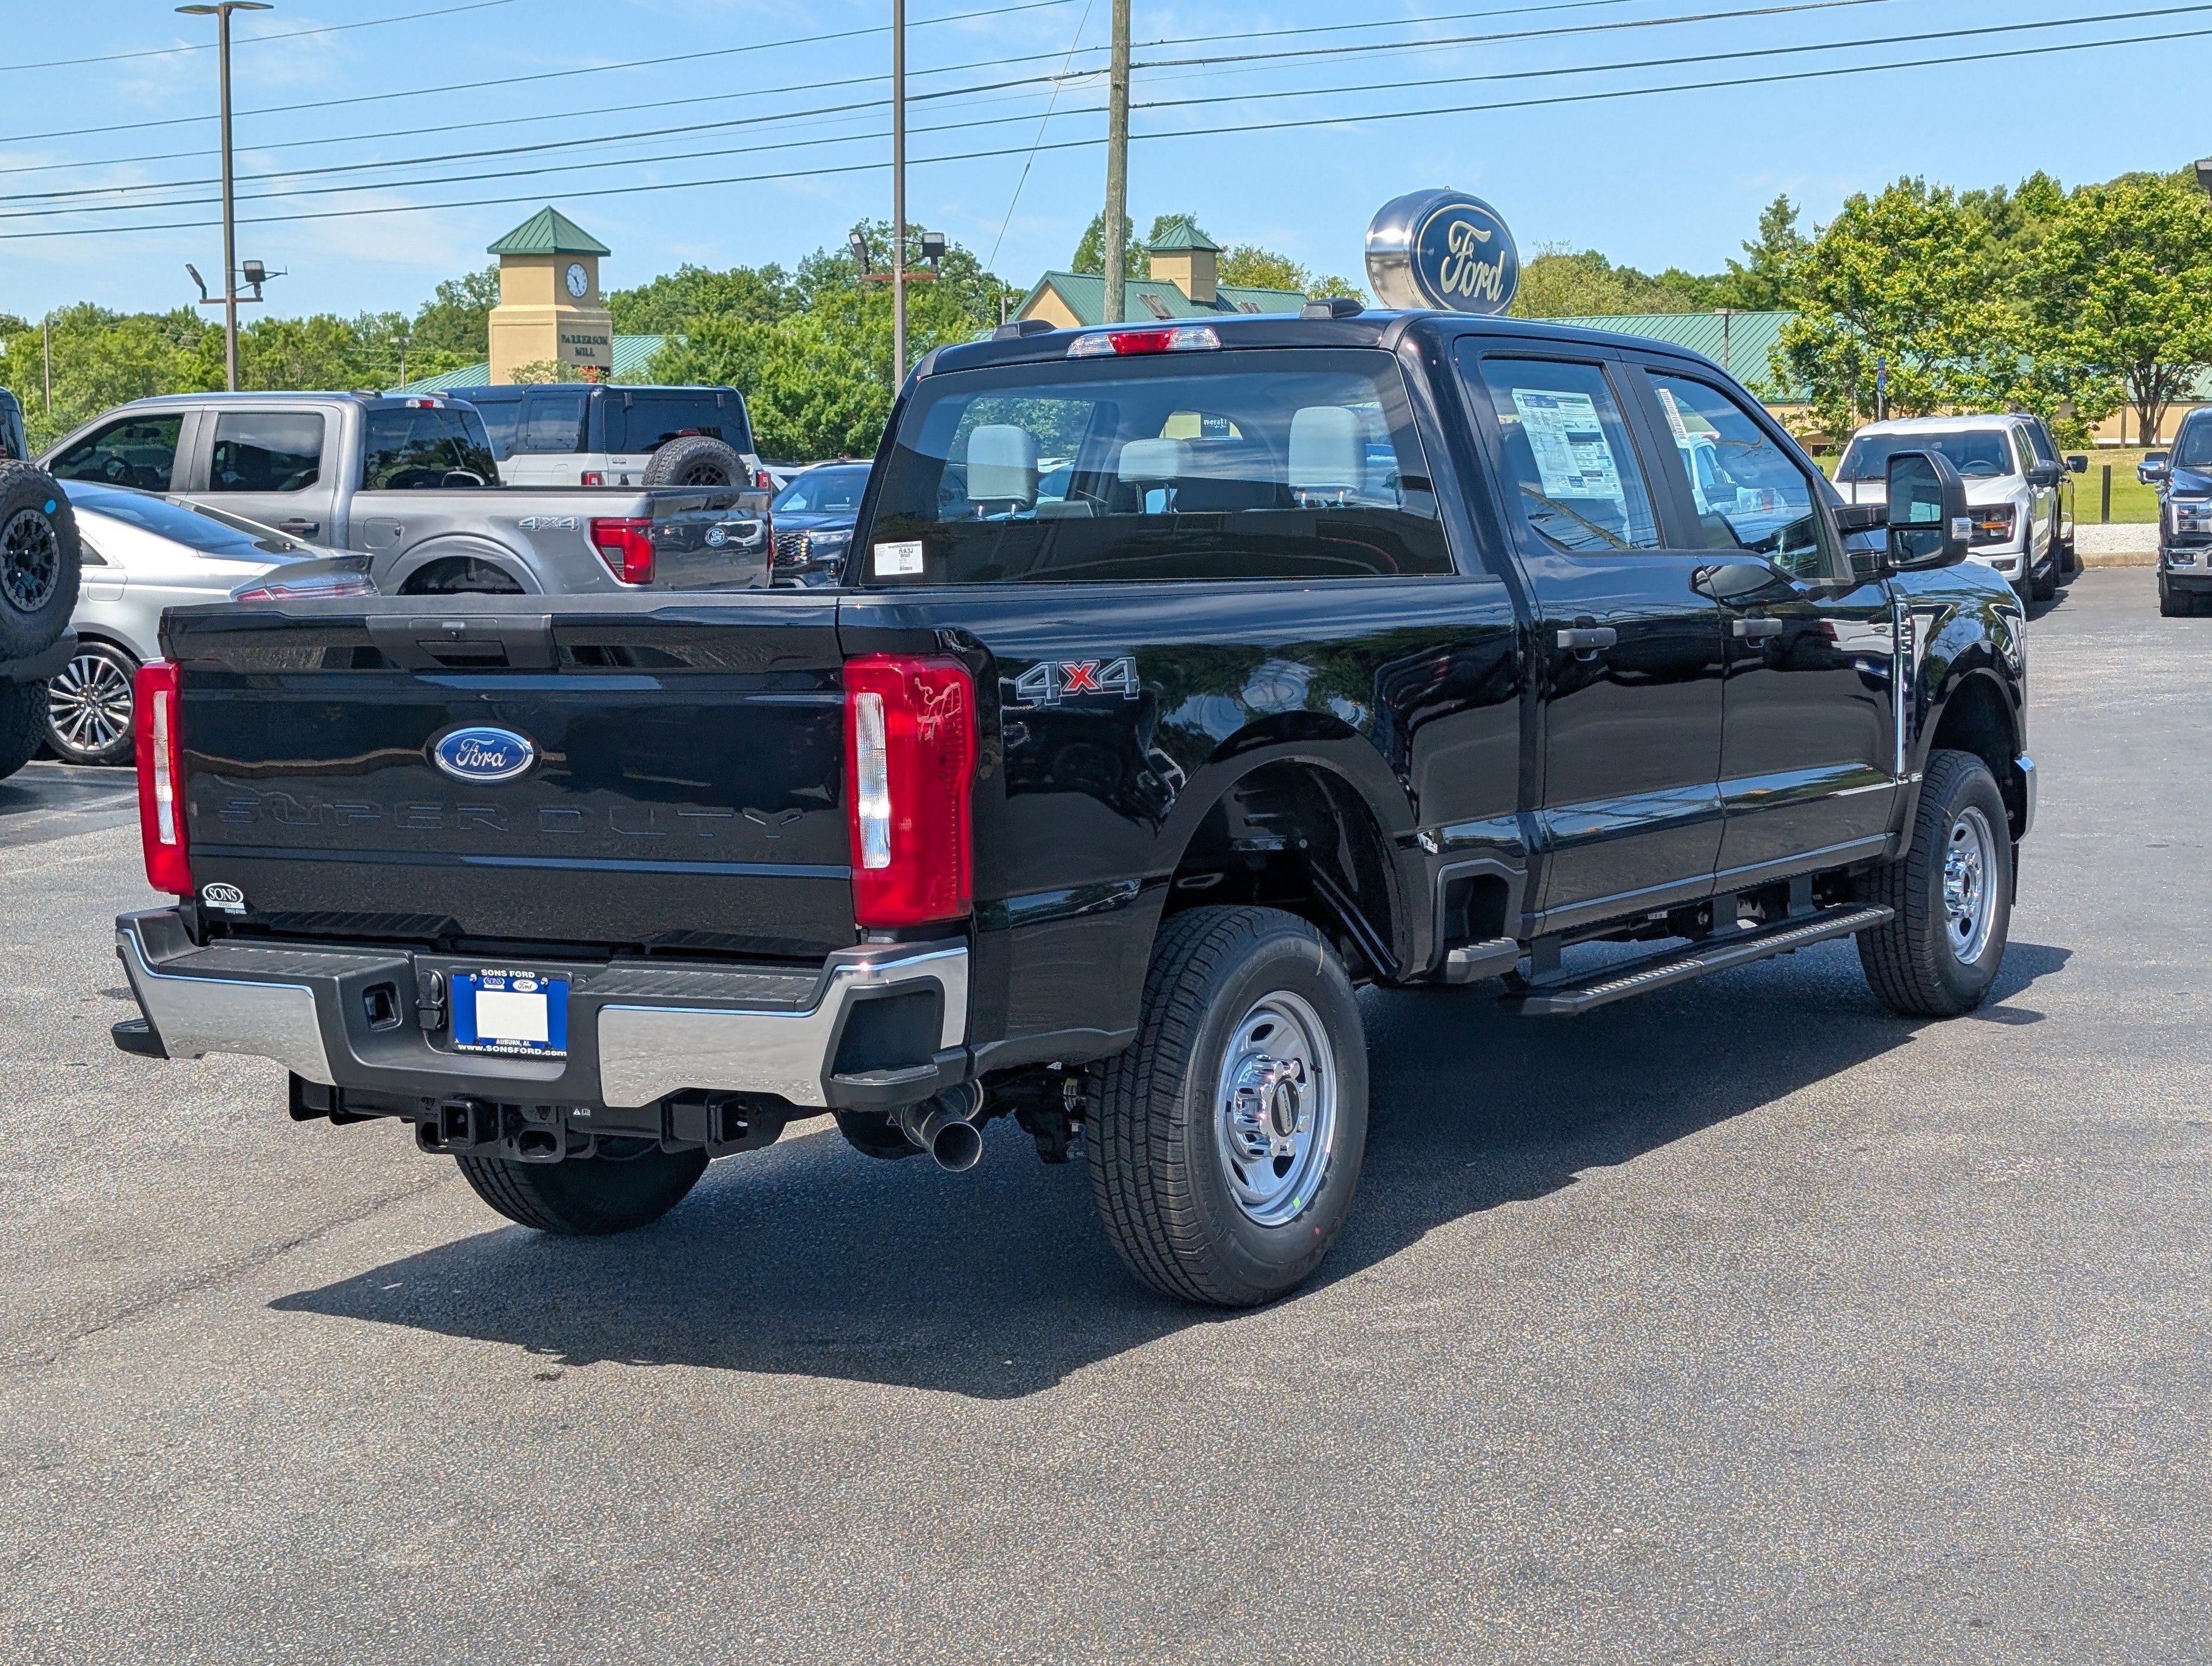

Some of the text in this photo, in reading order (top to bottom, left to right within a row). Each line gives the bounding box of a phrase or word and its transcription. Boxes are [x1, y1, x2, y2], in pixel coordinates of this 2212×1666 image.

[1440, 220, 1506, 302] Ford
[561, 334, 608, 345] PARKERSON
[575, 347, 595, 357] MILL
[456, 738, 507, 767] Ford
[218, 797, 803, 839] SUPER DUTY
[208, 887, 237, 901] SONS
[509, 970, 535, 978] FORD
[518, 981, 533, 989] Ford
[496, 1039, 522, 1047] AUBURN,
[458, 1044, 567, 1056] www.SONSFORD.com
